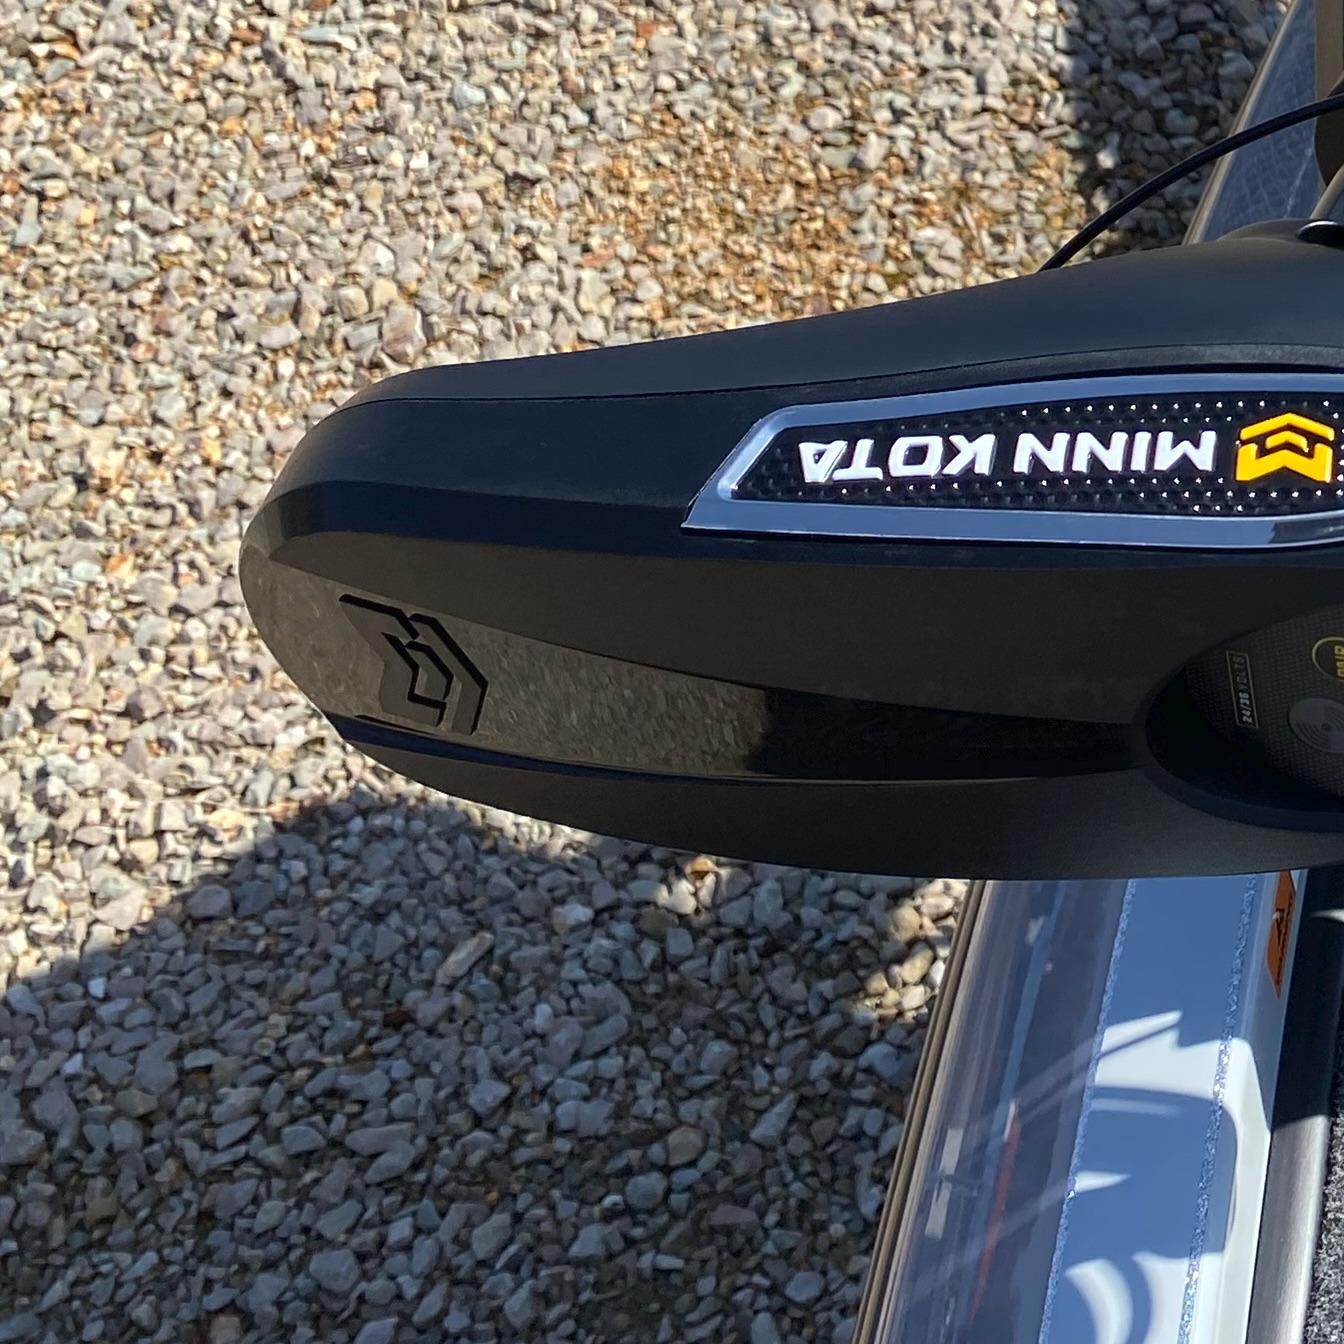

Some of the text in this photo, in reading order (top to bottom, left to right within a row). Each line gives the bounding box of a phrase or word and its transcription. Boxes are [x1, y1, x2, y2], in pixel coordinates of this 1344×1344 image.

[798, 430, 1218, 484] MINN KOTA
[1232, 656, 1249, 692] VOLTS
